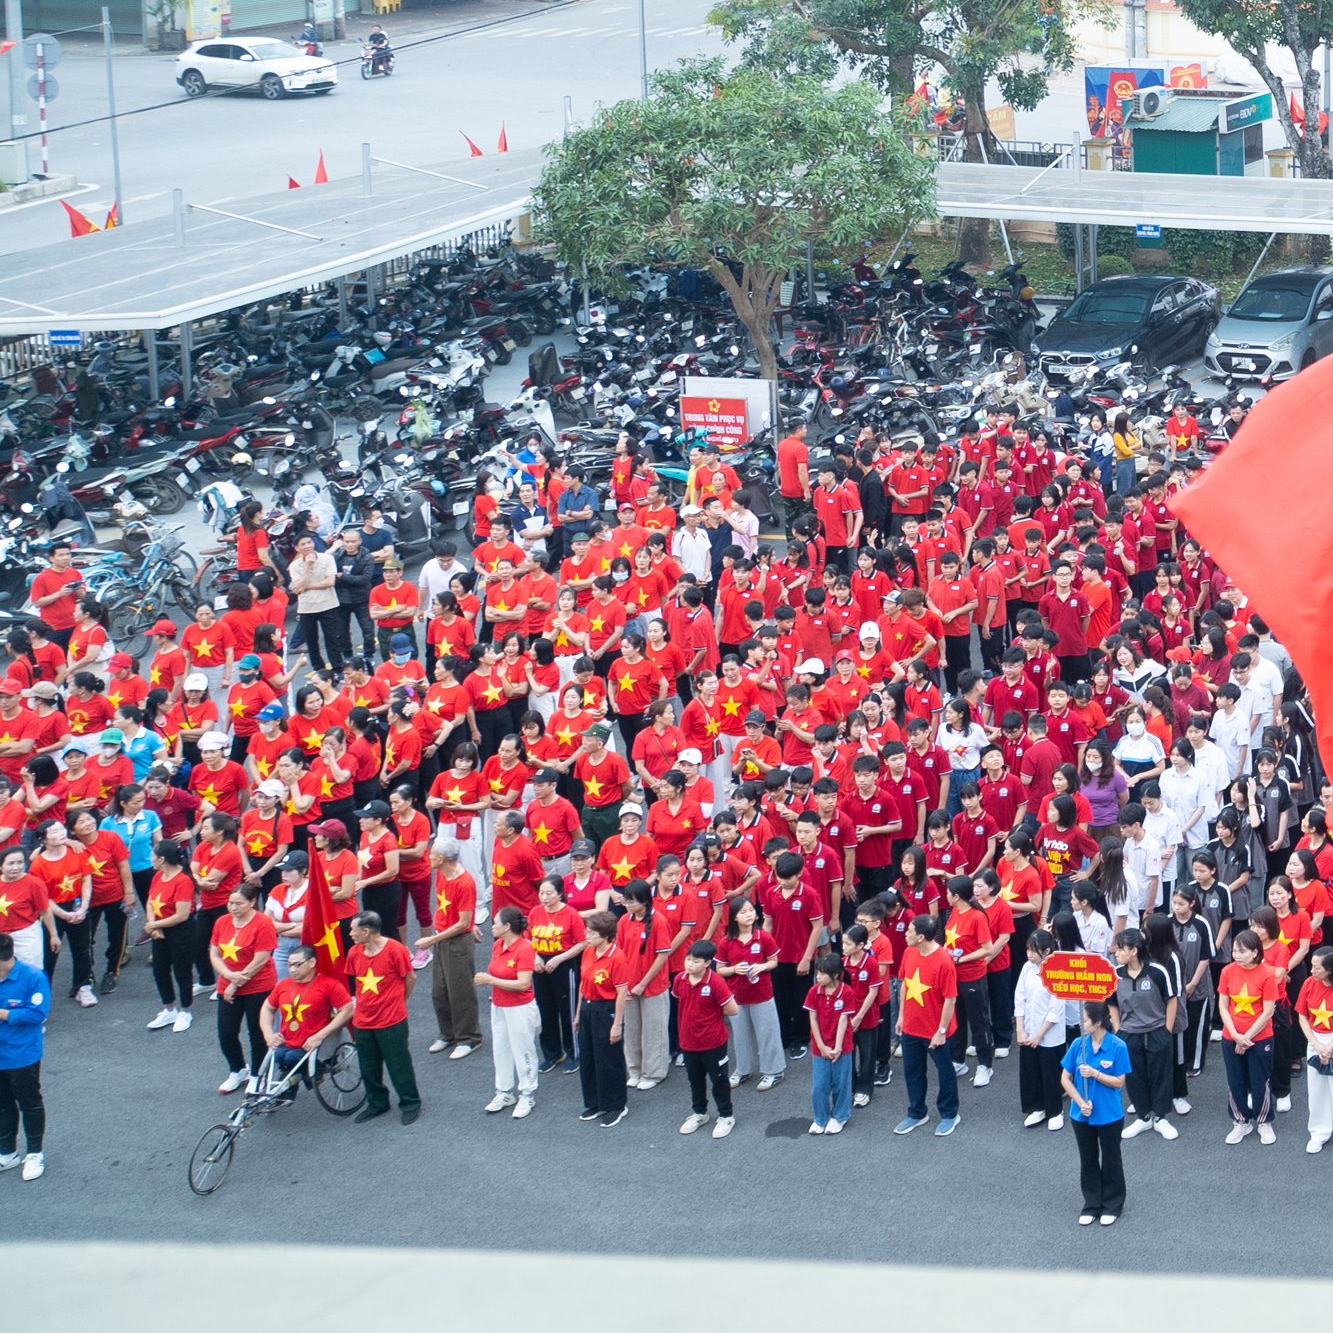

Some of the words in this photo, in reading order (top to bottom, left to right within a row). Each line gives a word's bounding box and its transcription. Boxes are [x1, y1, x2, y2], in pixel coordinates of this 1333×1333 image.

[684, 413, 704, 422] TRUNG
[705, 412, 718, 423] TÂM
[719, 415, 735, 425] PHỤC
[736, 415, 745, 425] VỤ
[726, 425, 742, 435] CÔNG
[1069, 957, 1087, 968] KHỐI
[1045, 969, 1075, 980] TRƯỜNG
[1096, 972, 1112, 982] NON
[1052, 981, 1068, 992] TIỂU
[1069, 984, 1087, 994] HỌC,
[1088, 985, 1107, 994] THCS
